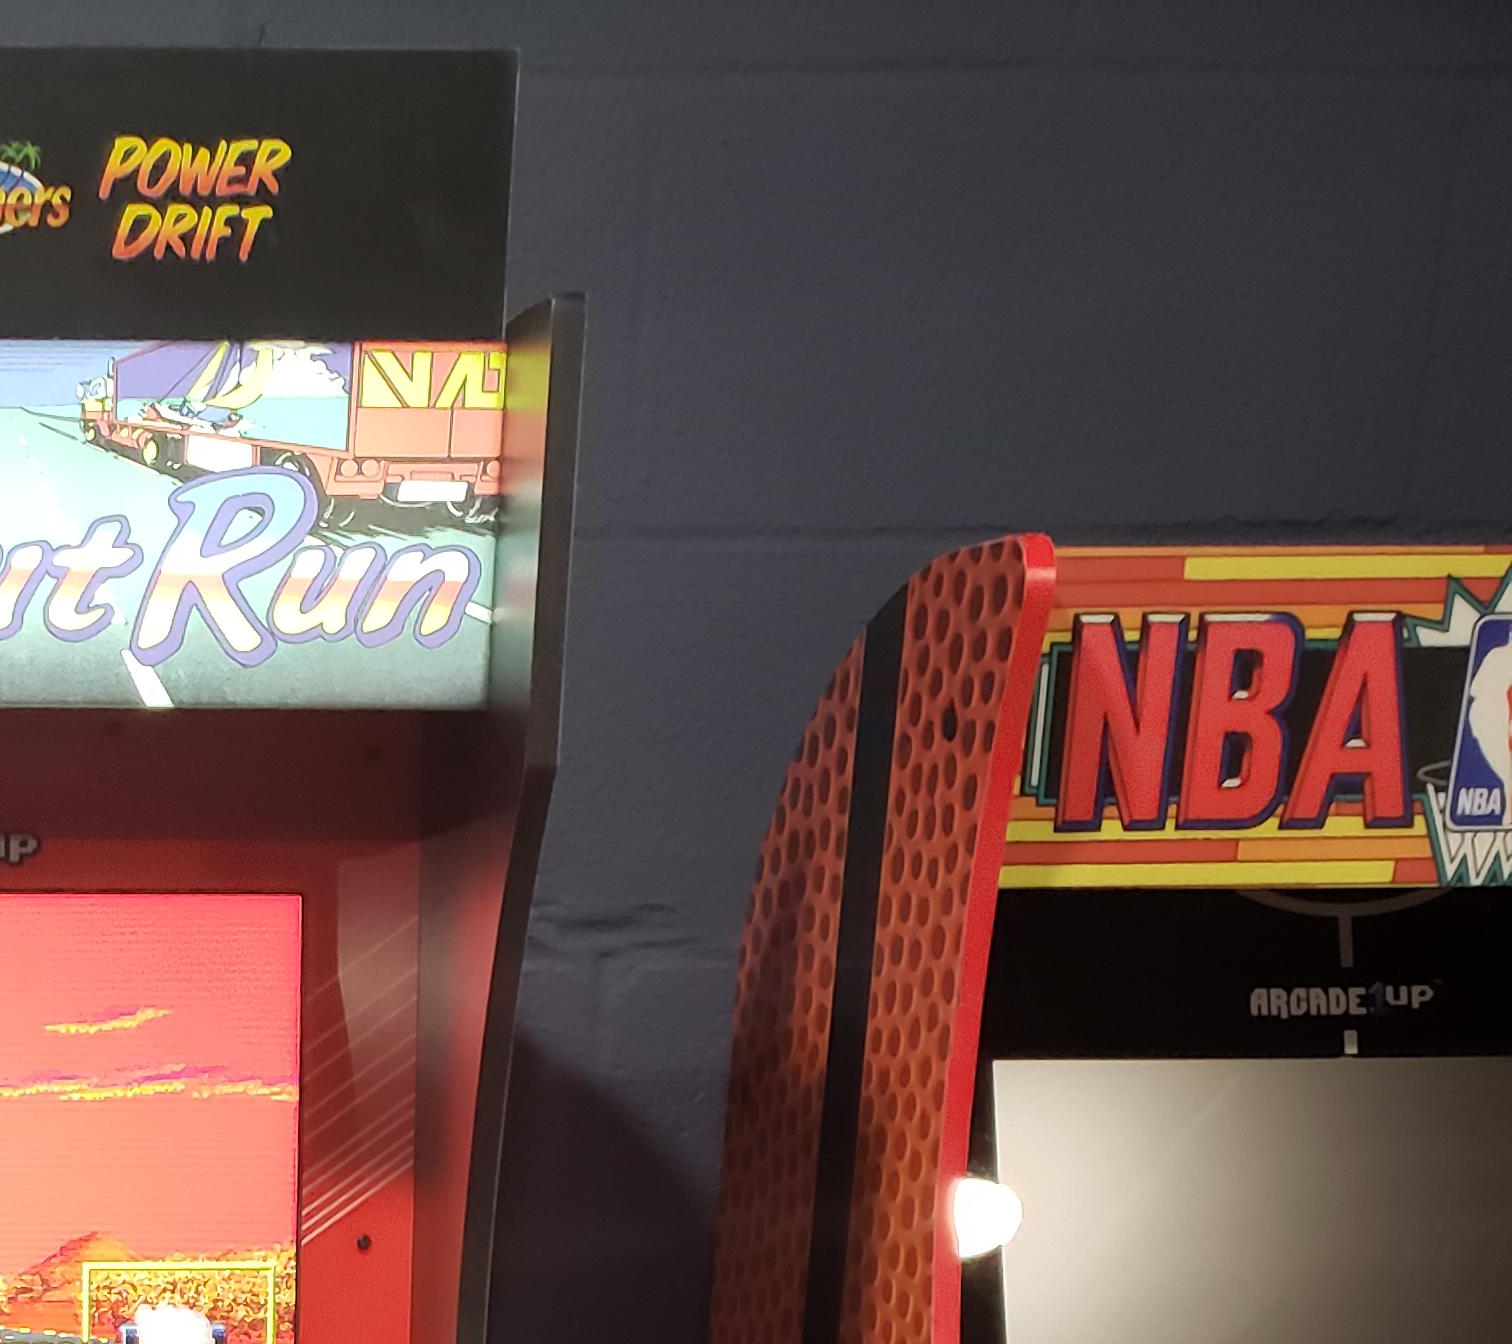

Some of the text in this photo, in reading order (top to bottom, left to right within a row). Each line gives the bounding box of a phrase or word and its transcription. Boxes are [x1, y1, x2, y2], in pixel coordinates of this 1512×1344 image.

[99, 134, 292, 200] POWER
[111, 204, 274, 263] DRIFT
[1054, 612, 1414, 832] NBA
[1455, 787, 1502, 817] NBA
